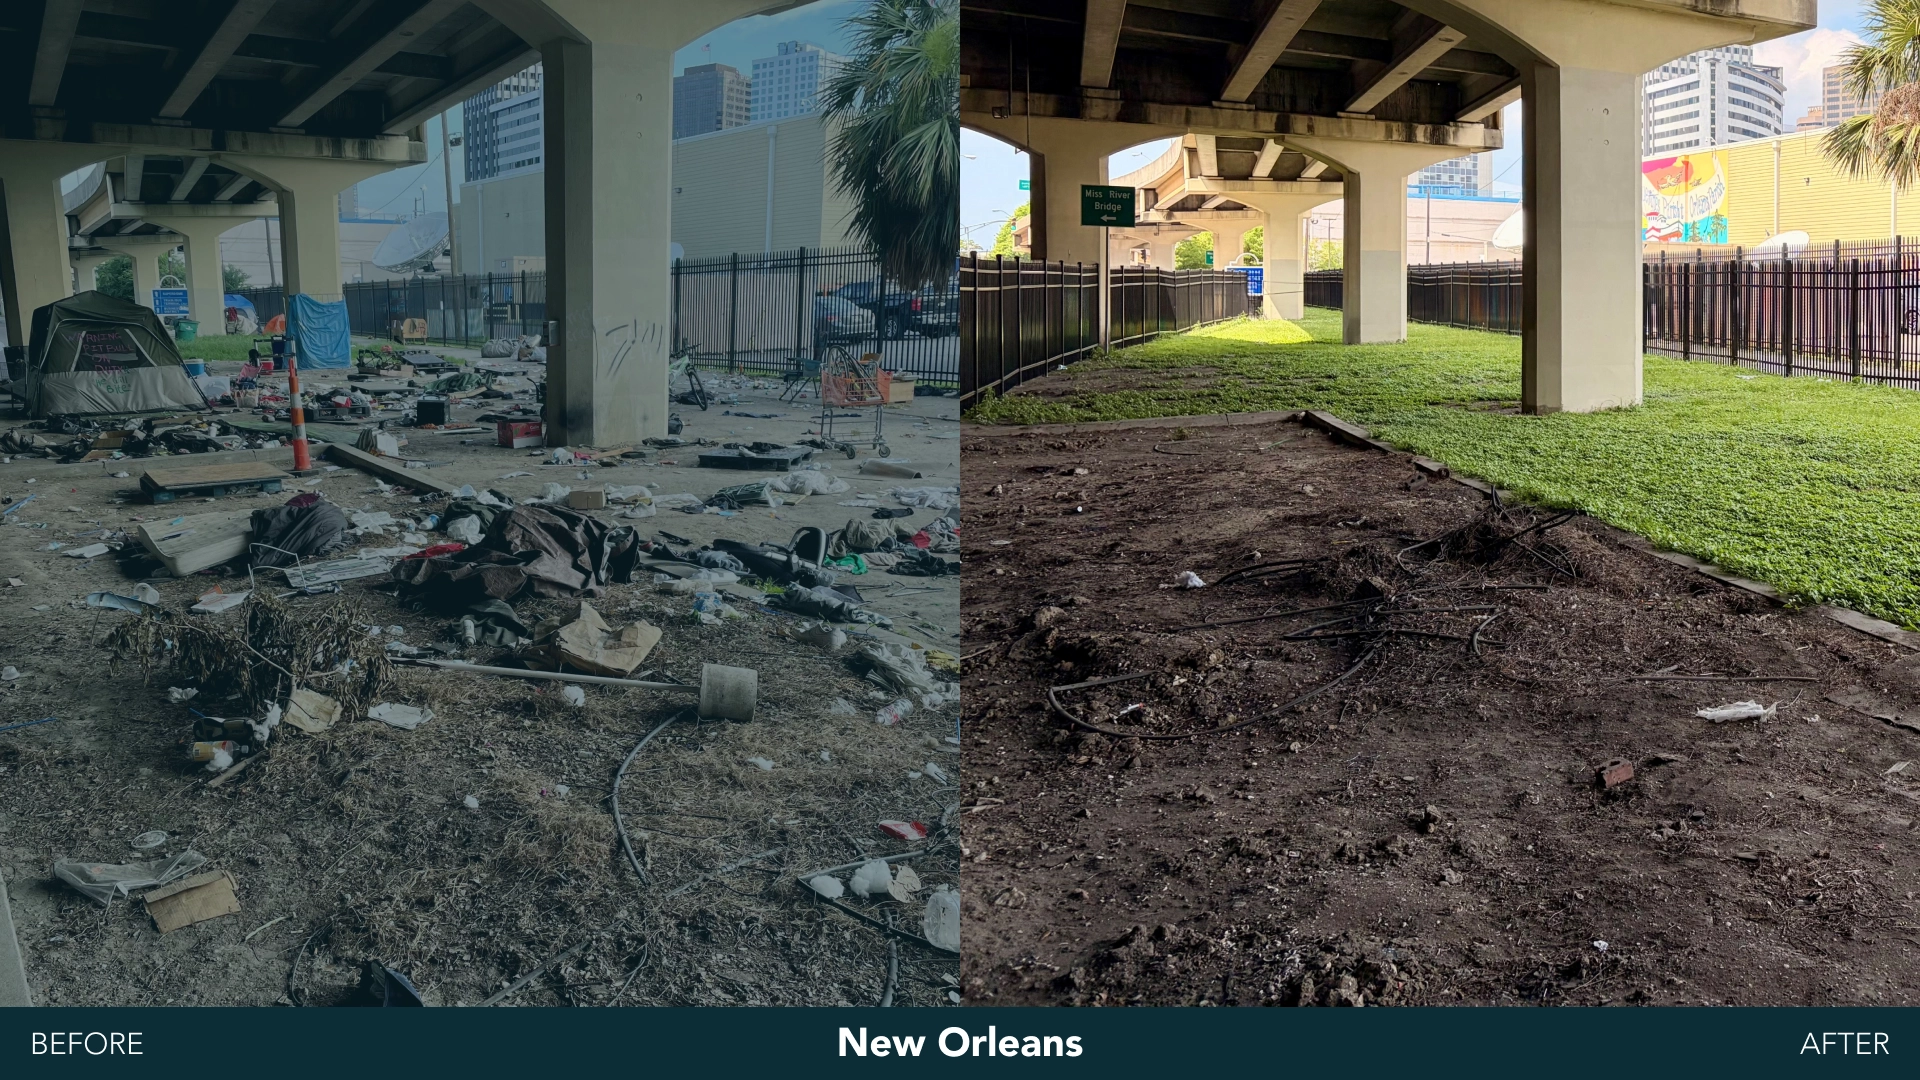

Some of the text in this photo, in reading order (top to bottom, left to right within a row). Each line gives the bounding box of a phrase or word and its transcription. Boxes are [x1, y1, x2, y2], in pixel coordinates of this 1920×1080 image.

[1085, 189, 1131, 199] Miss River
[1094, 202, 1122, 213] Bridge
[91, 353, 111, 364] ON
